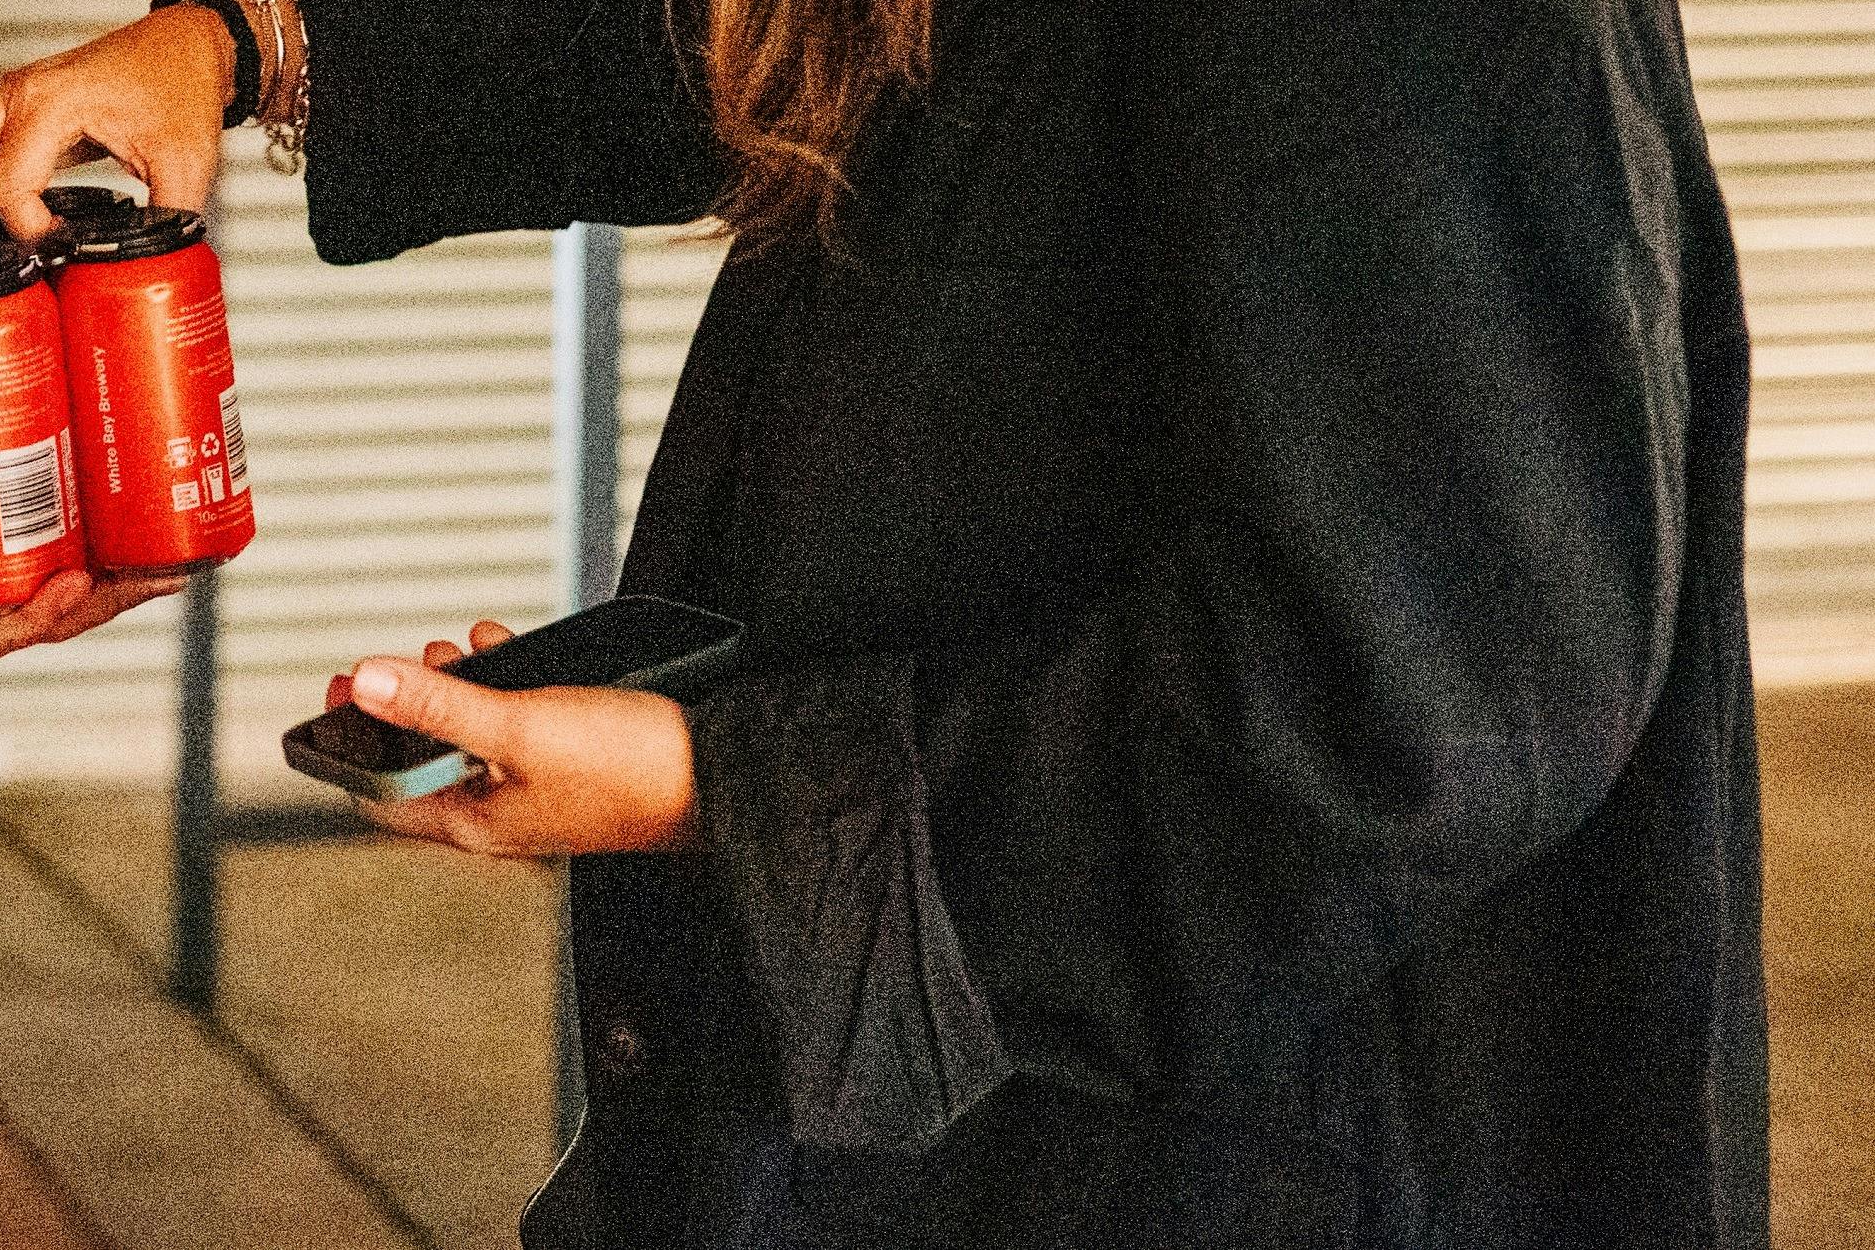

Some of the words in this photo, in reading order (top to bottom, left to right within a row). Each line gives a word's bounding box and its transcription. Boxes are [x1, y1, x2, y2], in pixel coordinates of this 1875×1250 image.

[93, 346, 111, 413] Brewery
[103, 414, 116, 444] Bay
[107, 446, 123, 494] White
